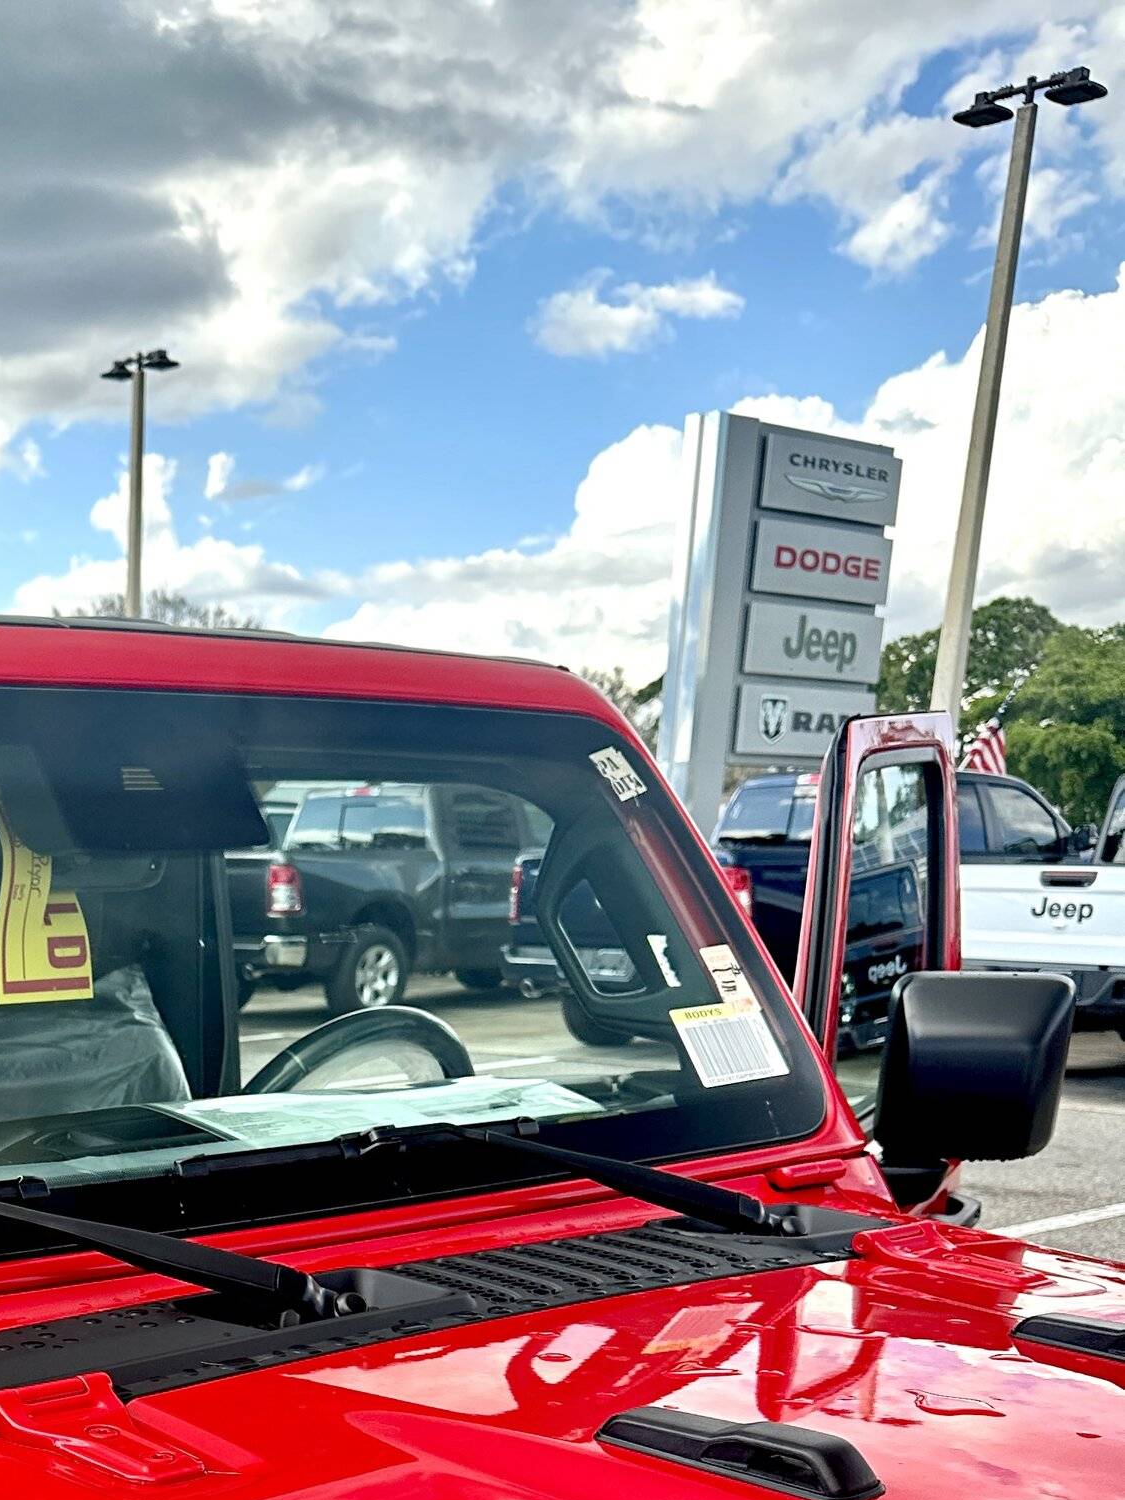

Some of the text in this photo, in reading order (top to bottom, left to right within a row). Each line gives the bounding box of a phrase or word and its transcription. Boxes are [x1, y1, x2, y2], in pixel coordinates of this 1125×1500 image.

[788, 452, 890, 483] CHRYSLER
[774, 544, 881, 582] DODGE
[782, 613, 858, 673] Jeep
[791, 711, 848, 734] RA
[1031, 895, 1094, 924] Jeep
